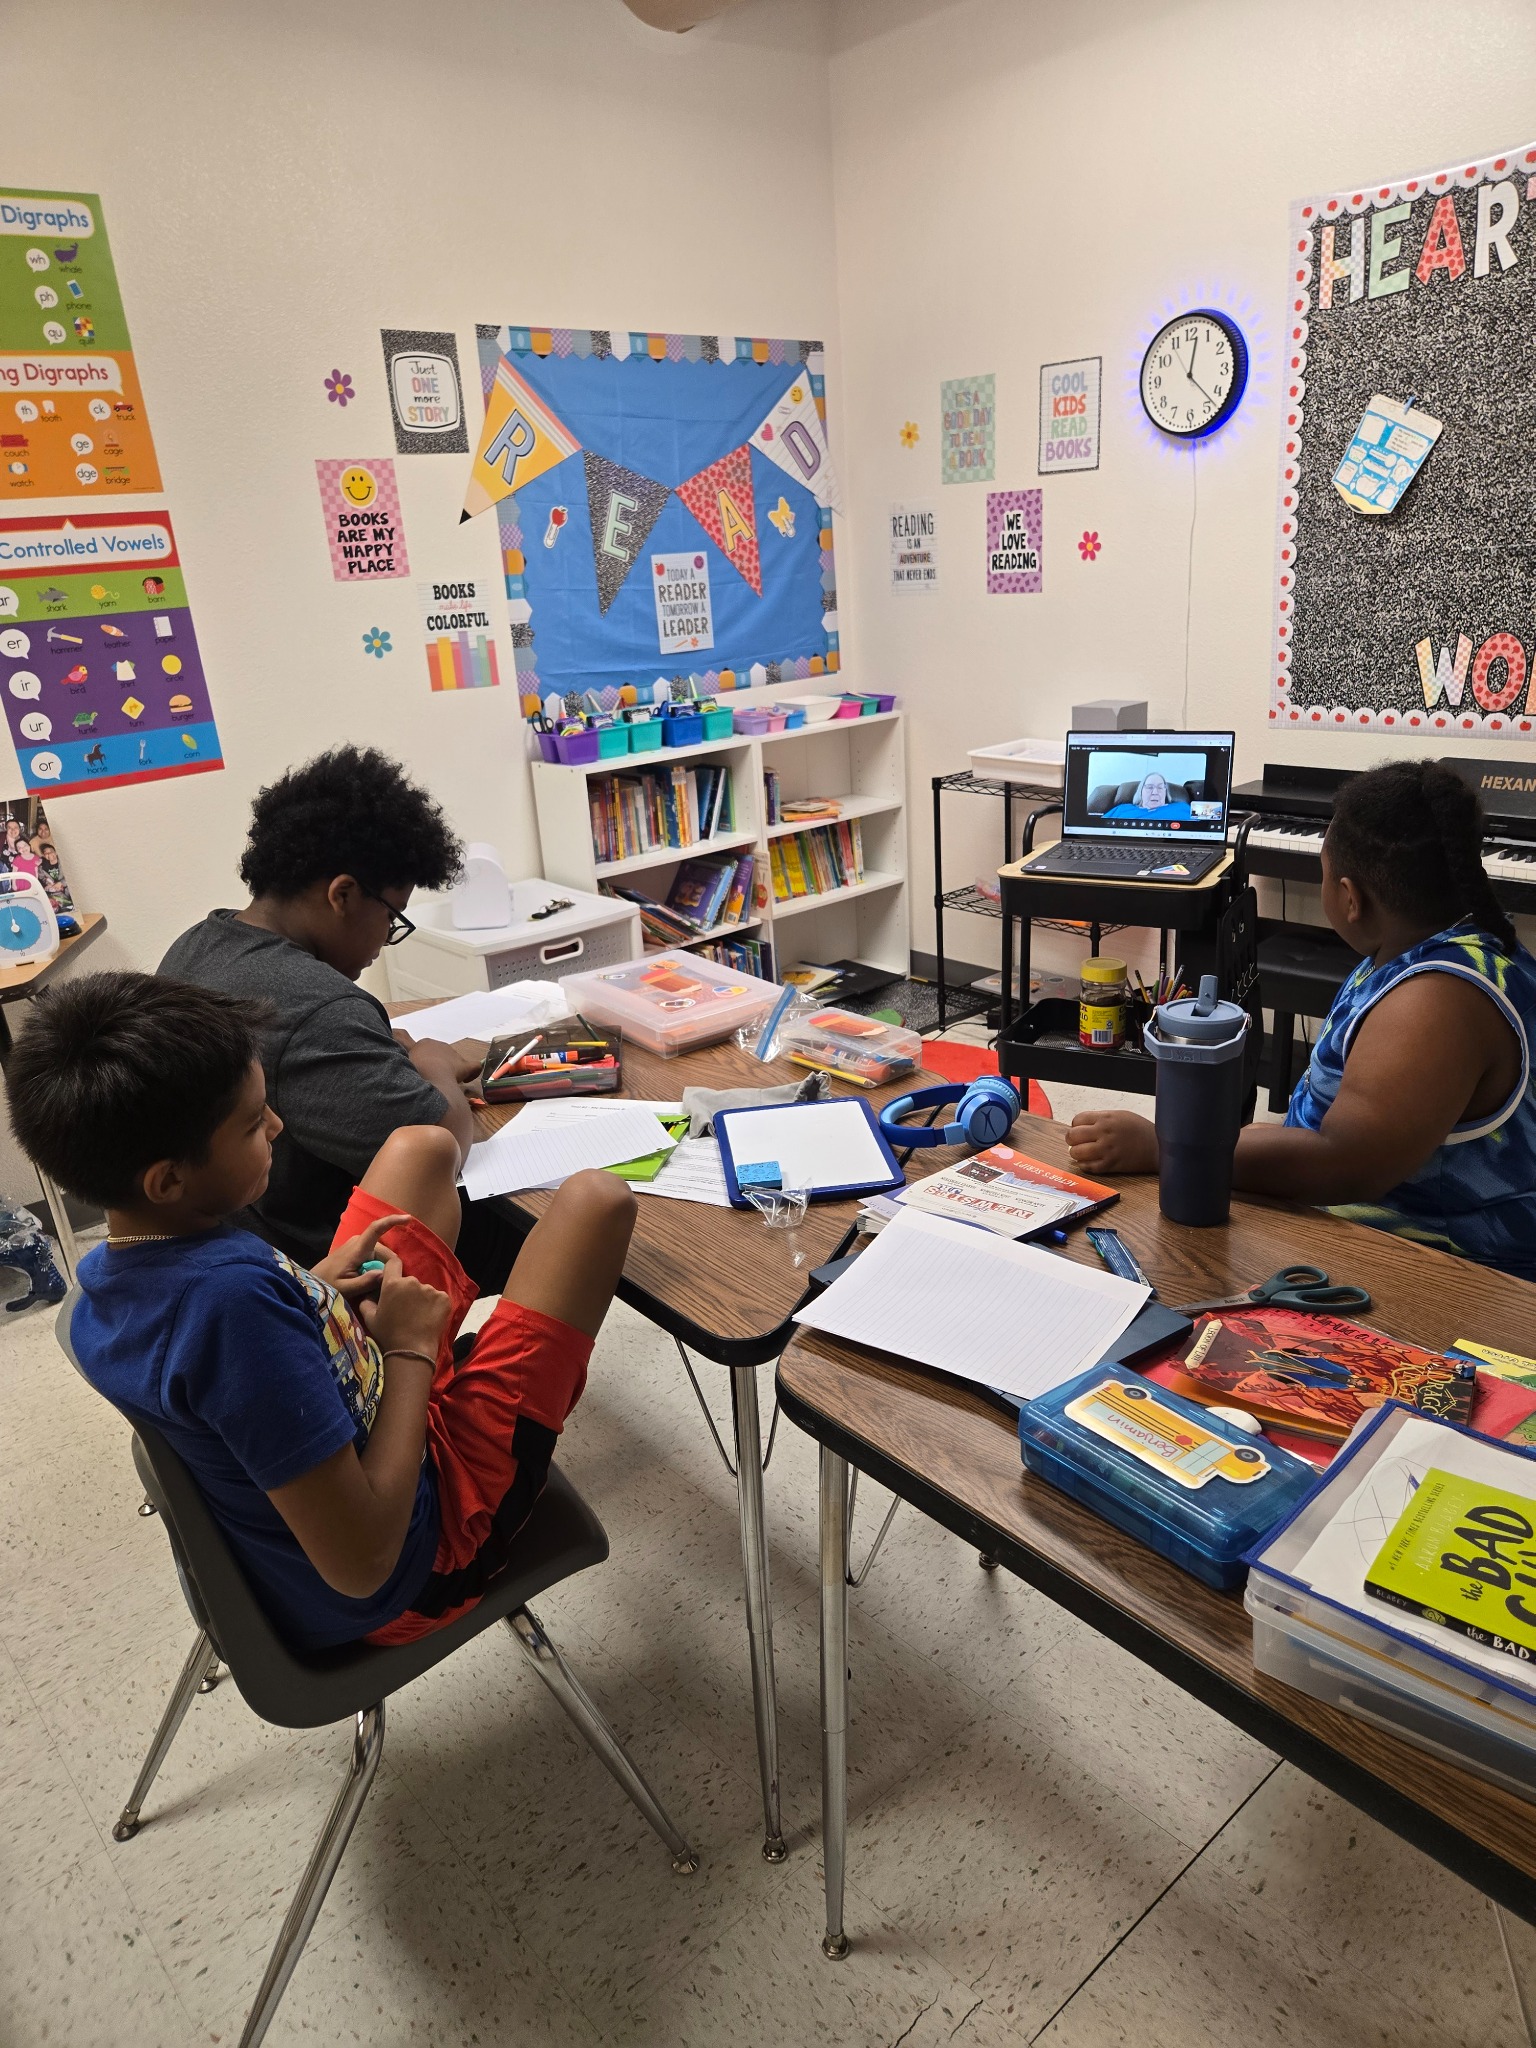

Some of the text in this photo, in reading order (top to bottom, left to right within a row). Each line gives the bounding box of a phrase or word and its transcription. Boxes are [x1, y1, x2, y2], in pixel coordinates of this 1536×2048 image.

[1, 204, 89, 232] Digraphs
[1319, 177, 1536, 310] HEAR
[30, 254, 46, 264] wh
[58, 266, 82, 274] whale
[40, 292, 54, 303] ph
[66, 302, 92, 312] phone
[48, 328, 62, 341] qu
[1185, 327, 1198, 341] 12
[1205, 330, 1210, 342] 1
[1172, 336, 1180, 350] 11
[1216, 341, 1224, 355] 2
[1159, 354, 1172, 368] 10
[408, 361, 438, 375] Just
[1220, 362, 1228, 376] 3
[23, 363, 108, 388] Digraphs
[1154, 376, 1161, 388] 9
[412, 377, 440, 393] ONE
[1052, 371, 1088, 395] COOL
[1214, 385, 1222, 396] 4
[1052, 394, 1087, 417] KIDS
[1160, 396, 1167, 408] 8
[1203, 401, 1211, 414] 5
[21, 406, 32, 415] th
[93, 404, 105, 414] ck
[408, 406, 449, 422] STORY
[1171, 406, 1178, 419] 7
[1186, 409, 1194, 421] 6
[41, 414, 62, 422] tooth
[944, 407, 992, 430] GOOD DAY
[1051, 417, 1087, 439] READ
[76, 440, 90, 450] ge
[1045, 438, 1092, 462] BOOKS
[4, 448, 30, 458] couch
[104, 448, 124, 456] cage
[959, 448, 986, 468] BOOK
[77, 468, 96, 480] dge
[106, 476, 130, 485] bridge
[10, 478, 34, 488] watch
[339, 512, 390, 528] BOOKS
[893, 513, 933, 537] READING
[1006, 513, 1021, 530] WE
[337, 527, 395, 544] ARE MY
[1002, 533, 1026, 550] LOVE
[0, 534, 165, 560] Controlled Vowels
[907, 538, 920, 549] IS AN
[342, 544, 394, 559] HAPPY
[900, 553, 931, 563] ADVENTURE
[348, 558, 396, 574] PLACE
[992, 552, 1037, 571] READING
[667, 568, 695, 581] TODAY A
[894, 569, 935, 581] THAT NEVER ENDS
[433, 583, 476, 600] BOOKS
[658, 583, 706, 603] READER
[46, 604, 67, 612] shark
[99, 600, 117, 610] yarn
[662, 602, 706, 617] TOMORROW A
[427, 612, 489, 631] COLORFUL
[663, 617, 709, 637] LEADER
[7, 639, 22, 649] er
[104, 640, 130, 649] feather
[155, 635, 176, 645] paper
[51, 645, 83, 654] hammer
[165, 674, 184, 683] circle
[1415, 632, 1536, 715] WO
[21, 680, 30, 691] ir
[70, 686, 86, 695] bird
[120, 680, 136, 688] shirt
[129, 719, 144, 727] turn
[172, 712, 195, 722] burger
[29, 721, 44, 732] ur
[78, 725, 97, 734] turtle
[184, 750, 200, 758] corn
[39, 760, 55, 771] or
[138, 757, 152, 765] fork
[87, 765, 108, 774] horse
[1013, 1161, 1079, 1187] ACTOR'S SCRIPT
[1419, 1370, 1455, 1420] DRAGO
[1107, 1415, 1178, 1457] Benjamin
[1392, 1548, 1403, 1562] NEW
[1400, 1538, 1410, 1551] YORK
[1406, 1522, 1420, 1537] TIMES
[1413, 1497, 1436, 1525] BESTSELLING
[1430, 1483, 1445, 1498] SERIES
[1415, 1495, 1464, 1571] AARON BLABEY
[1440, 1506, 1534, 1590] BAD
[1460, 1581, 1483, 1601] the
[1467, 1627, 1530, 1660] the BAD
